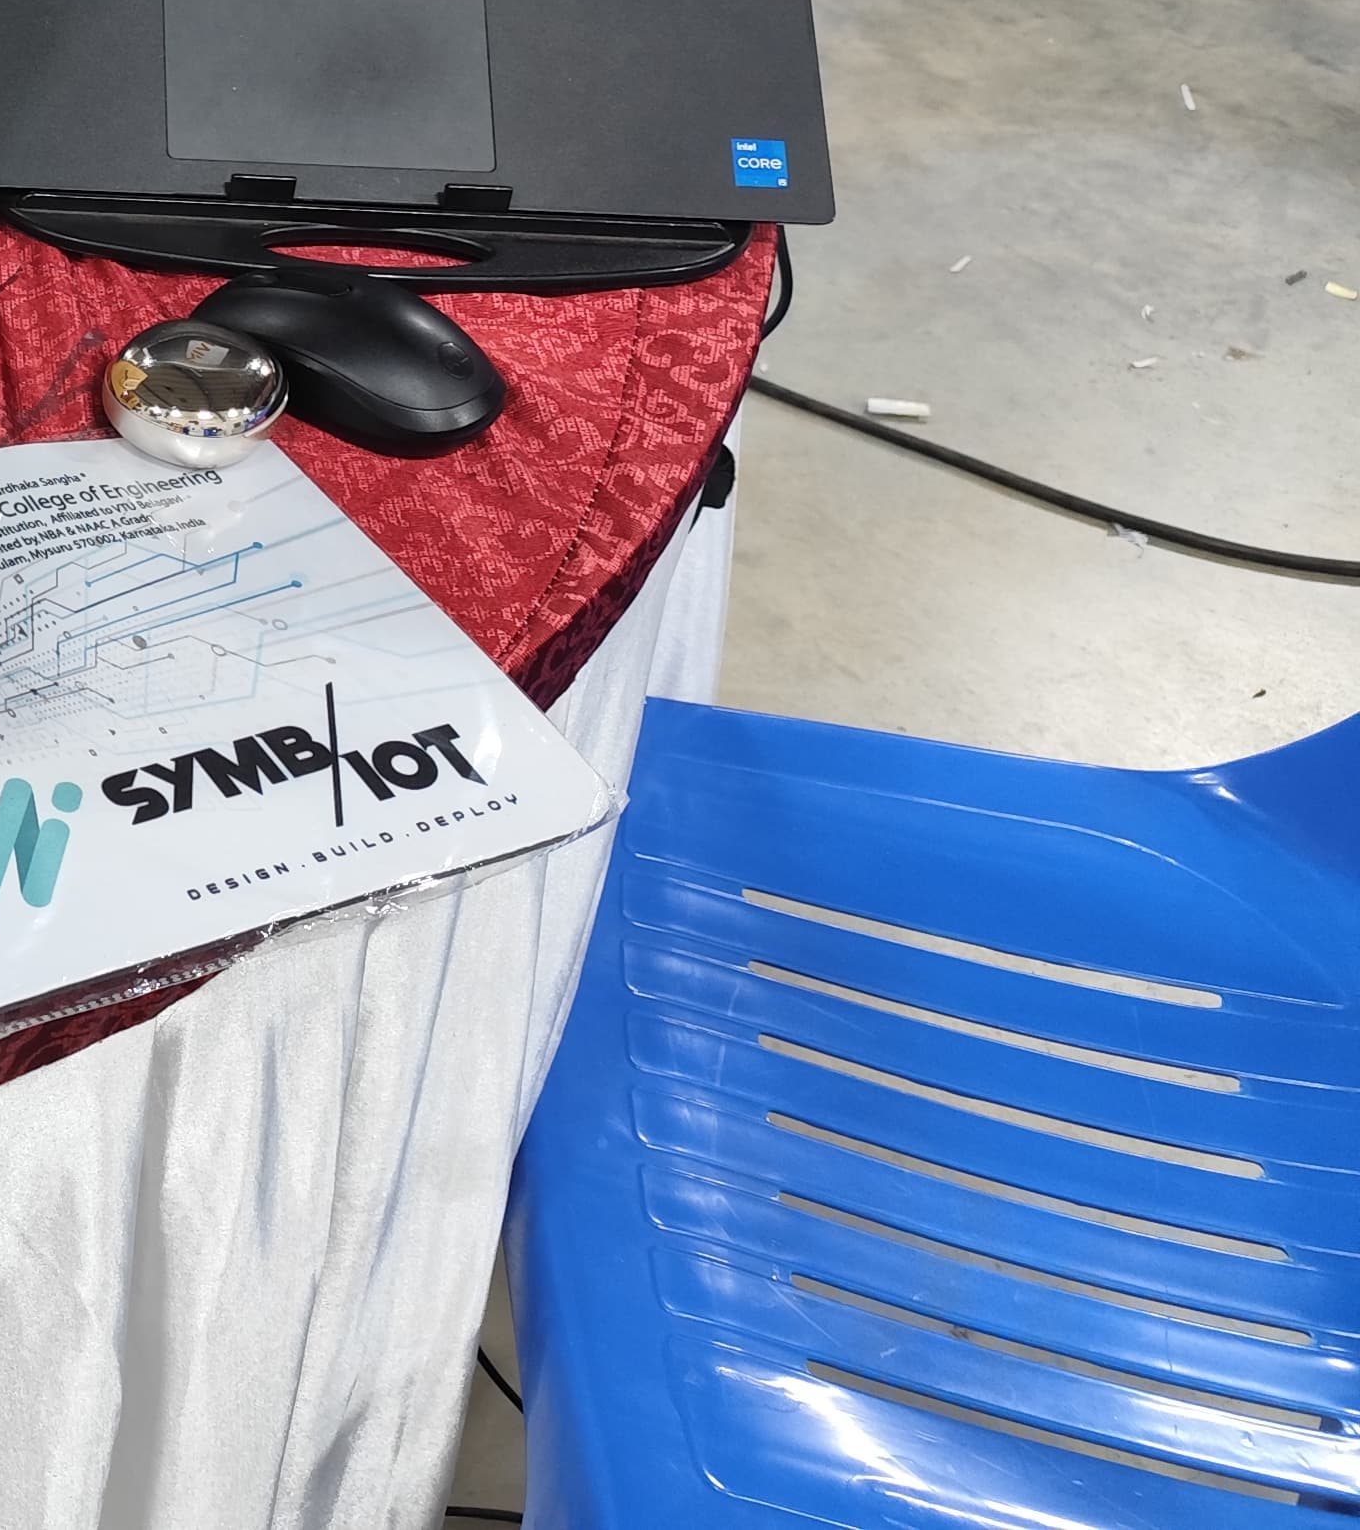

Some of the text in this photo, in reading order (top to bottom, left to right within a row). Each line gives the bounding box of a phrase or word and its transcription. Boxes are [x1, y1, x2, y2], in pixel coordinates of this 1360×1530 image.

[0, 486, 78, 521] College
[80, 484, 98, 503] of
[102, 469, 222, 499] Engineering
[51, 507, 99, 525] Affiliated
[100, 507, 111, 517] to
[111, 500, 137, 514] VTU
[30, 541, 73, 563] Mysuru
[178, 517, 205, 530] India
[40, 529, 65, 545] NBA
[66, 526, 76, 535] &
[75, 521, 109, 539] NAAC
[110, 518, 120, 528] A
